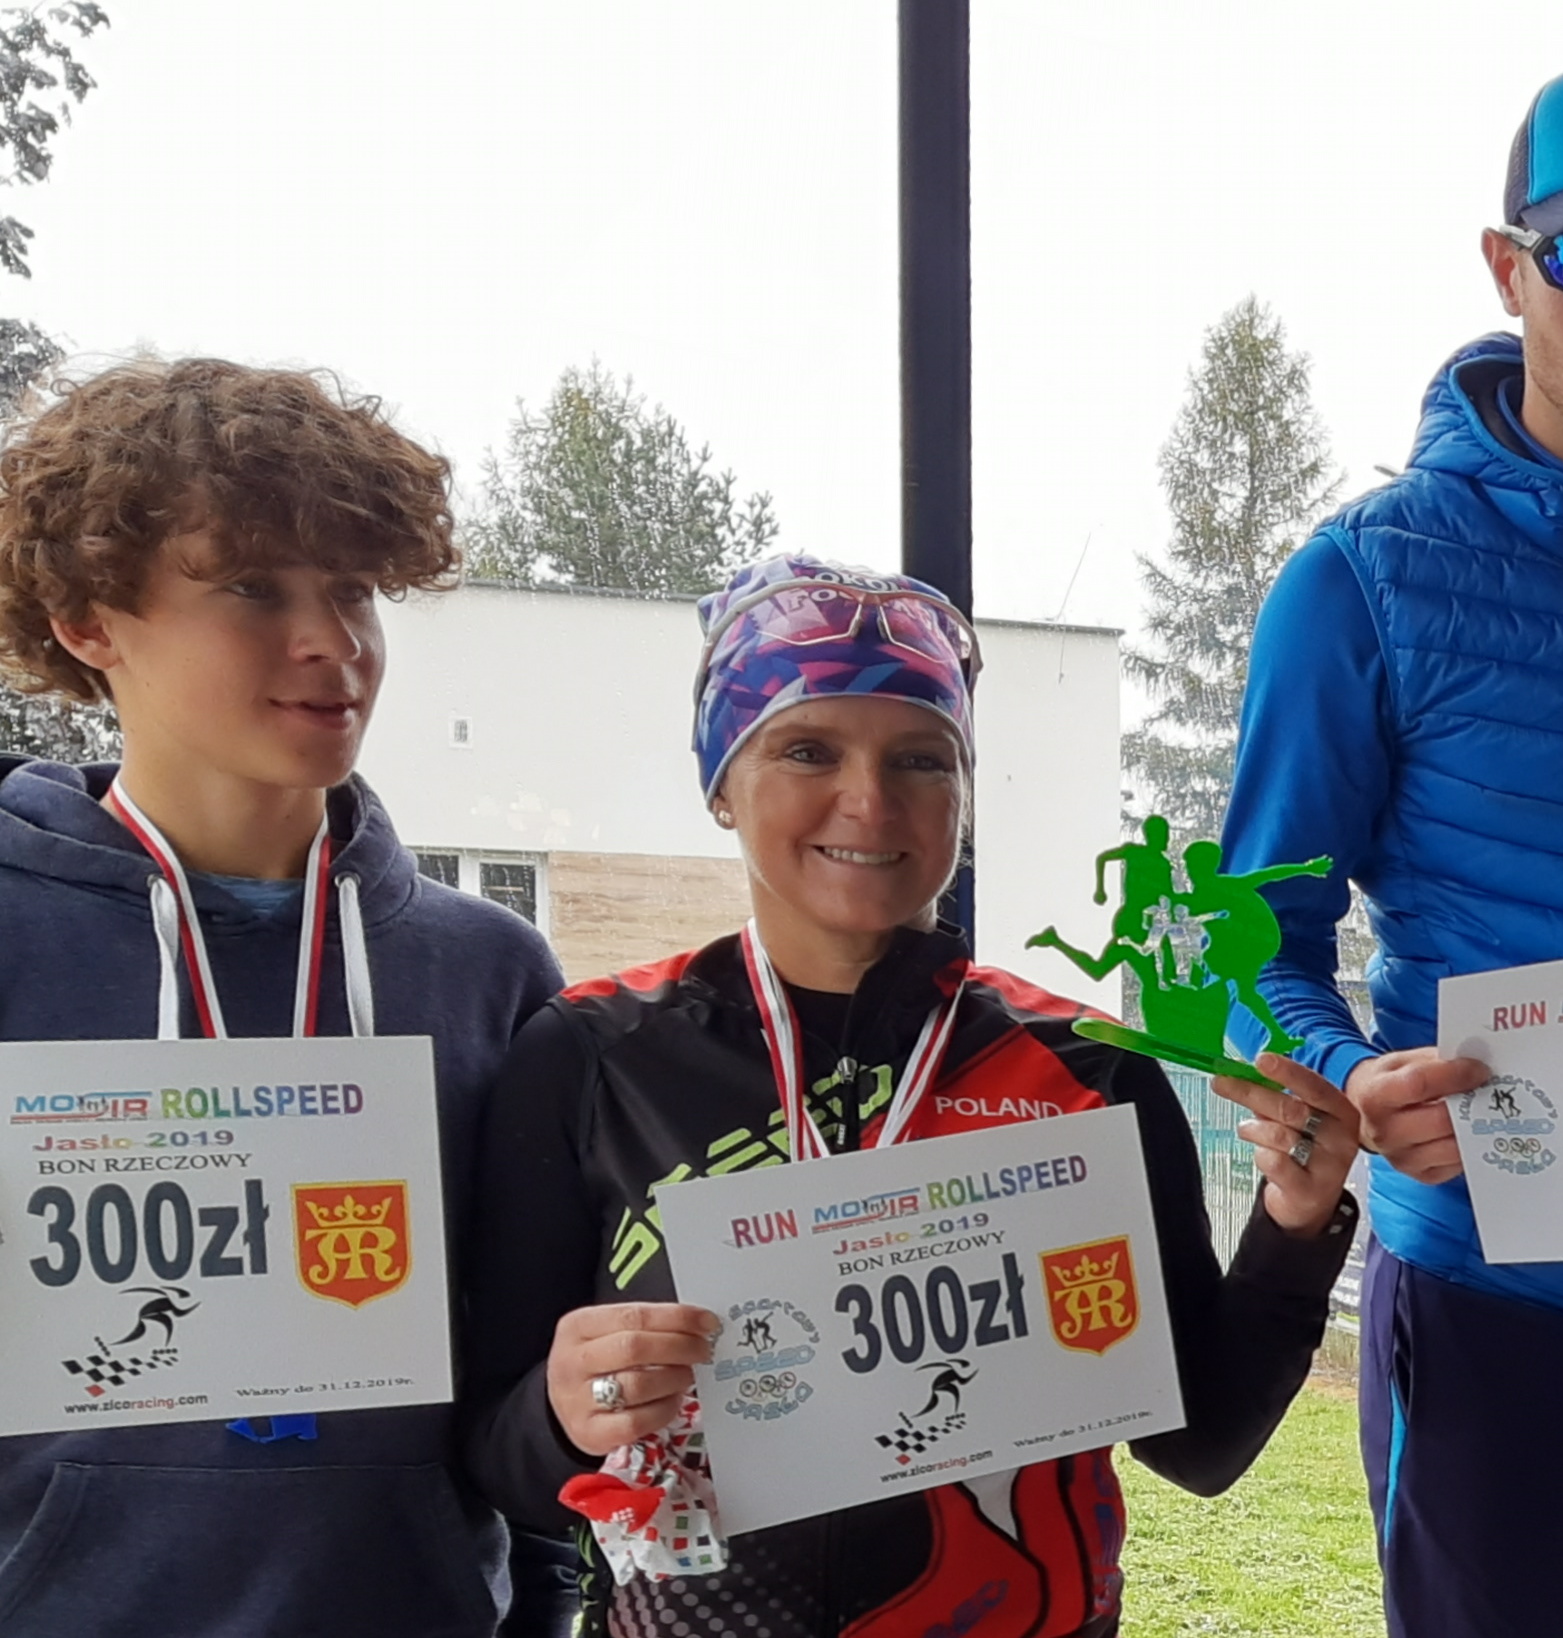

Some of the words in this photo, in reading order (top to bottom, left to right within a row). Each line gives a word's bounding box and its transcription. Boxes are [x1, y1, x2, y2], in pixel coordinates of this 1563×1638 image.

[1493, 1001, 1547, 1031] RUN
[160, 1083, 364, 1119] ROLLSPEED
[934, 1096, 1063, 1120] POLAND
[146, 1129, 235, 1149] 2019
[38, 1159, 96, 1175] BON
[104, 1153, 252, 1173] RZECZOWY
[730, 1209, 799, 1249] RUN
[926, 1154, 1088, 1210] ROLLSPEED
[27, 1178, 270, 1288] 300zł
[920, 1212, 990, 1238] 2019
[838, 1255, 885, 1276] BON
[890, 1230, 1006, 1266] RZECZOWY
[834, 1252, 1030, 1374] 300zł
[64, 1394, 208, 1415] www.zicoracing.com
[880, 1450, 993, 1483] www.zicoracing.com
